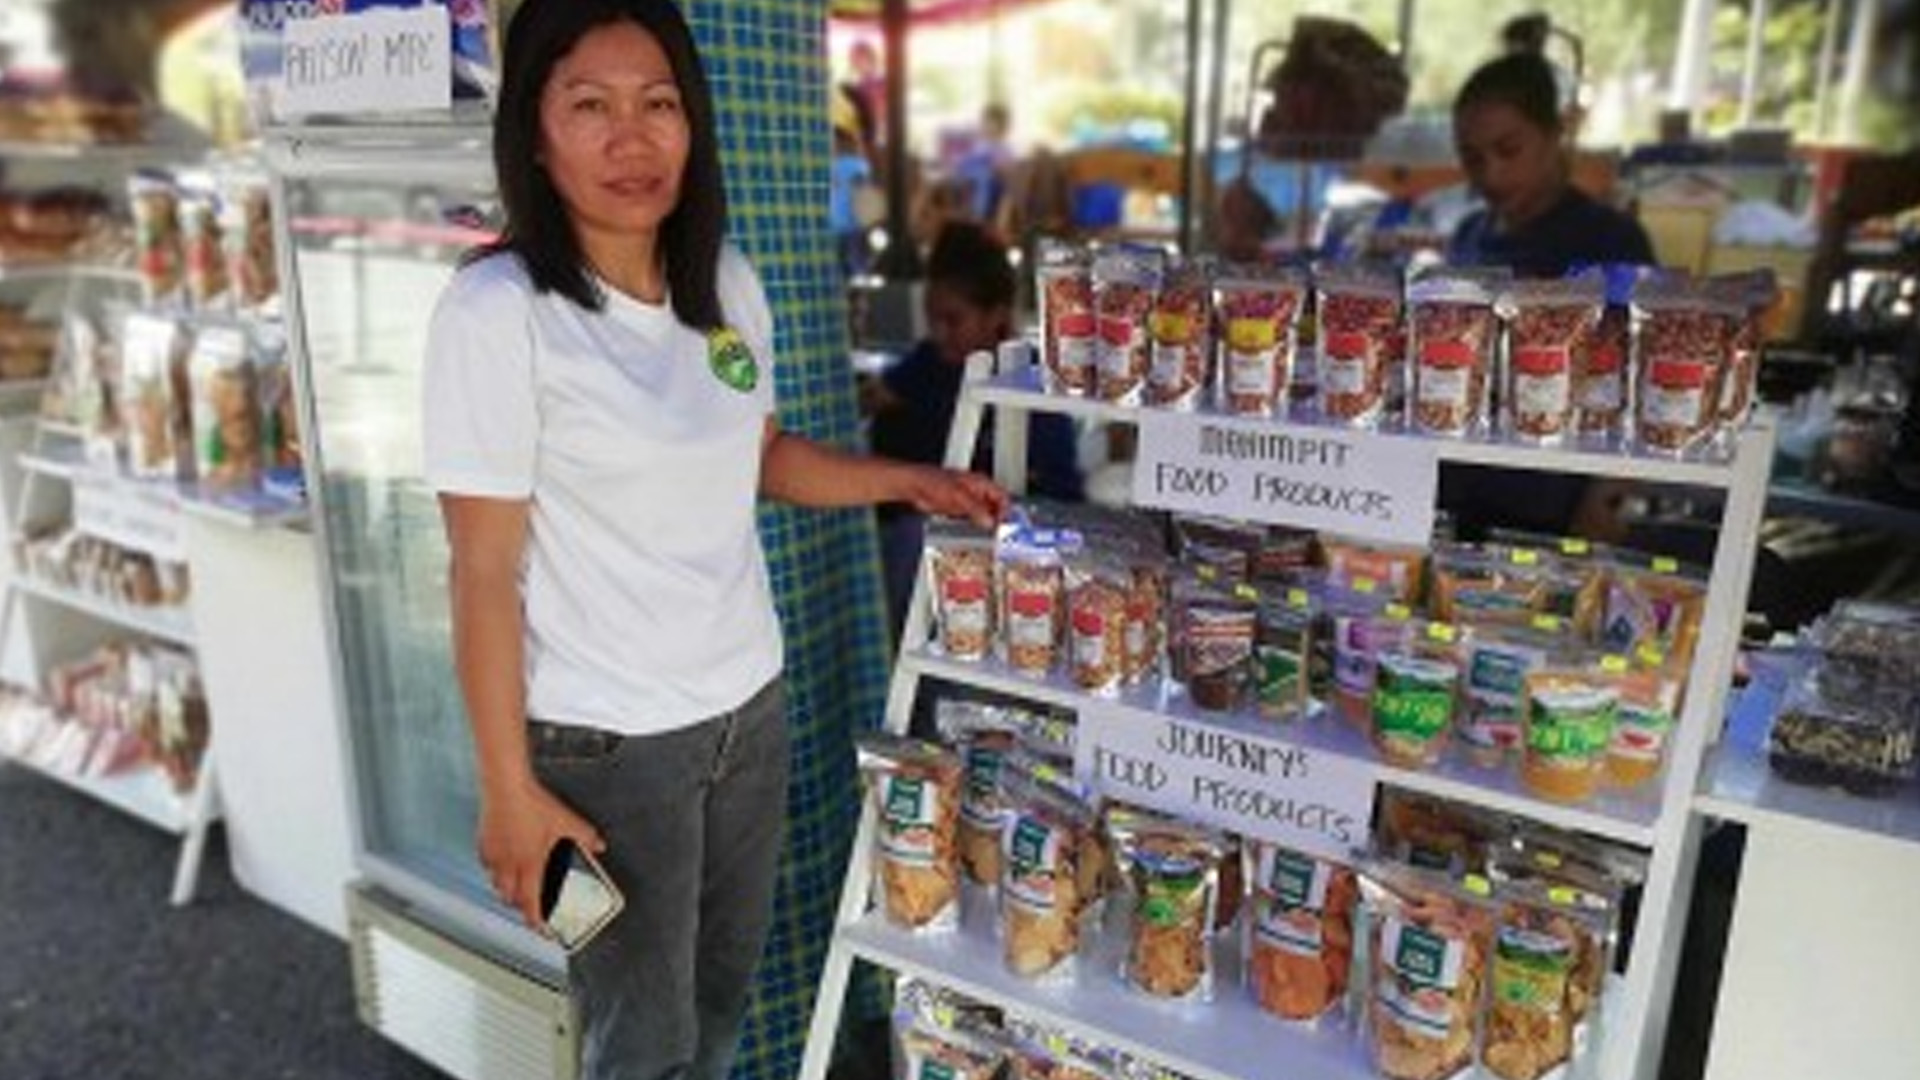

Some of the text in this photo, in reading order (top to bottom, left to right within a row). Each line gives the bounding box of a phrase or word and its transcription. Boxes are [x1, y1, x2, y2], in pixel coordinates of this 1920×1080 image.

[1155, 461, 1393, 521] FOOD PRODUCTS
[1092, 744, 1354, 843] FOOD PRODUCTS
